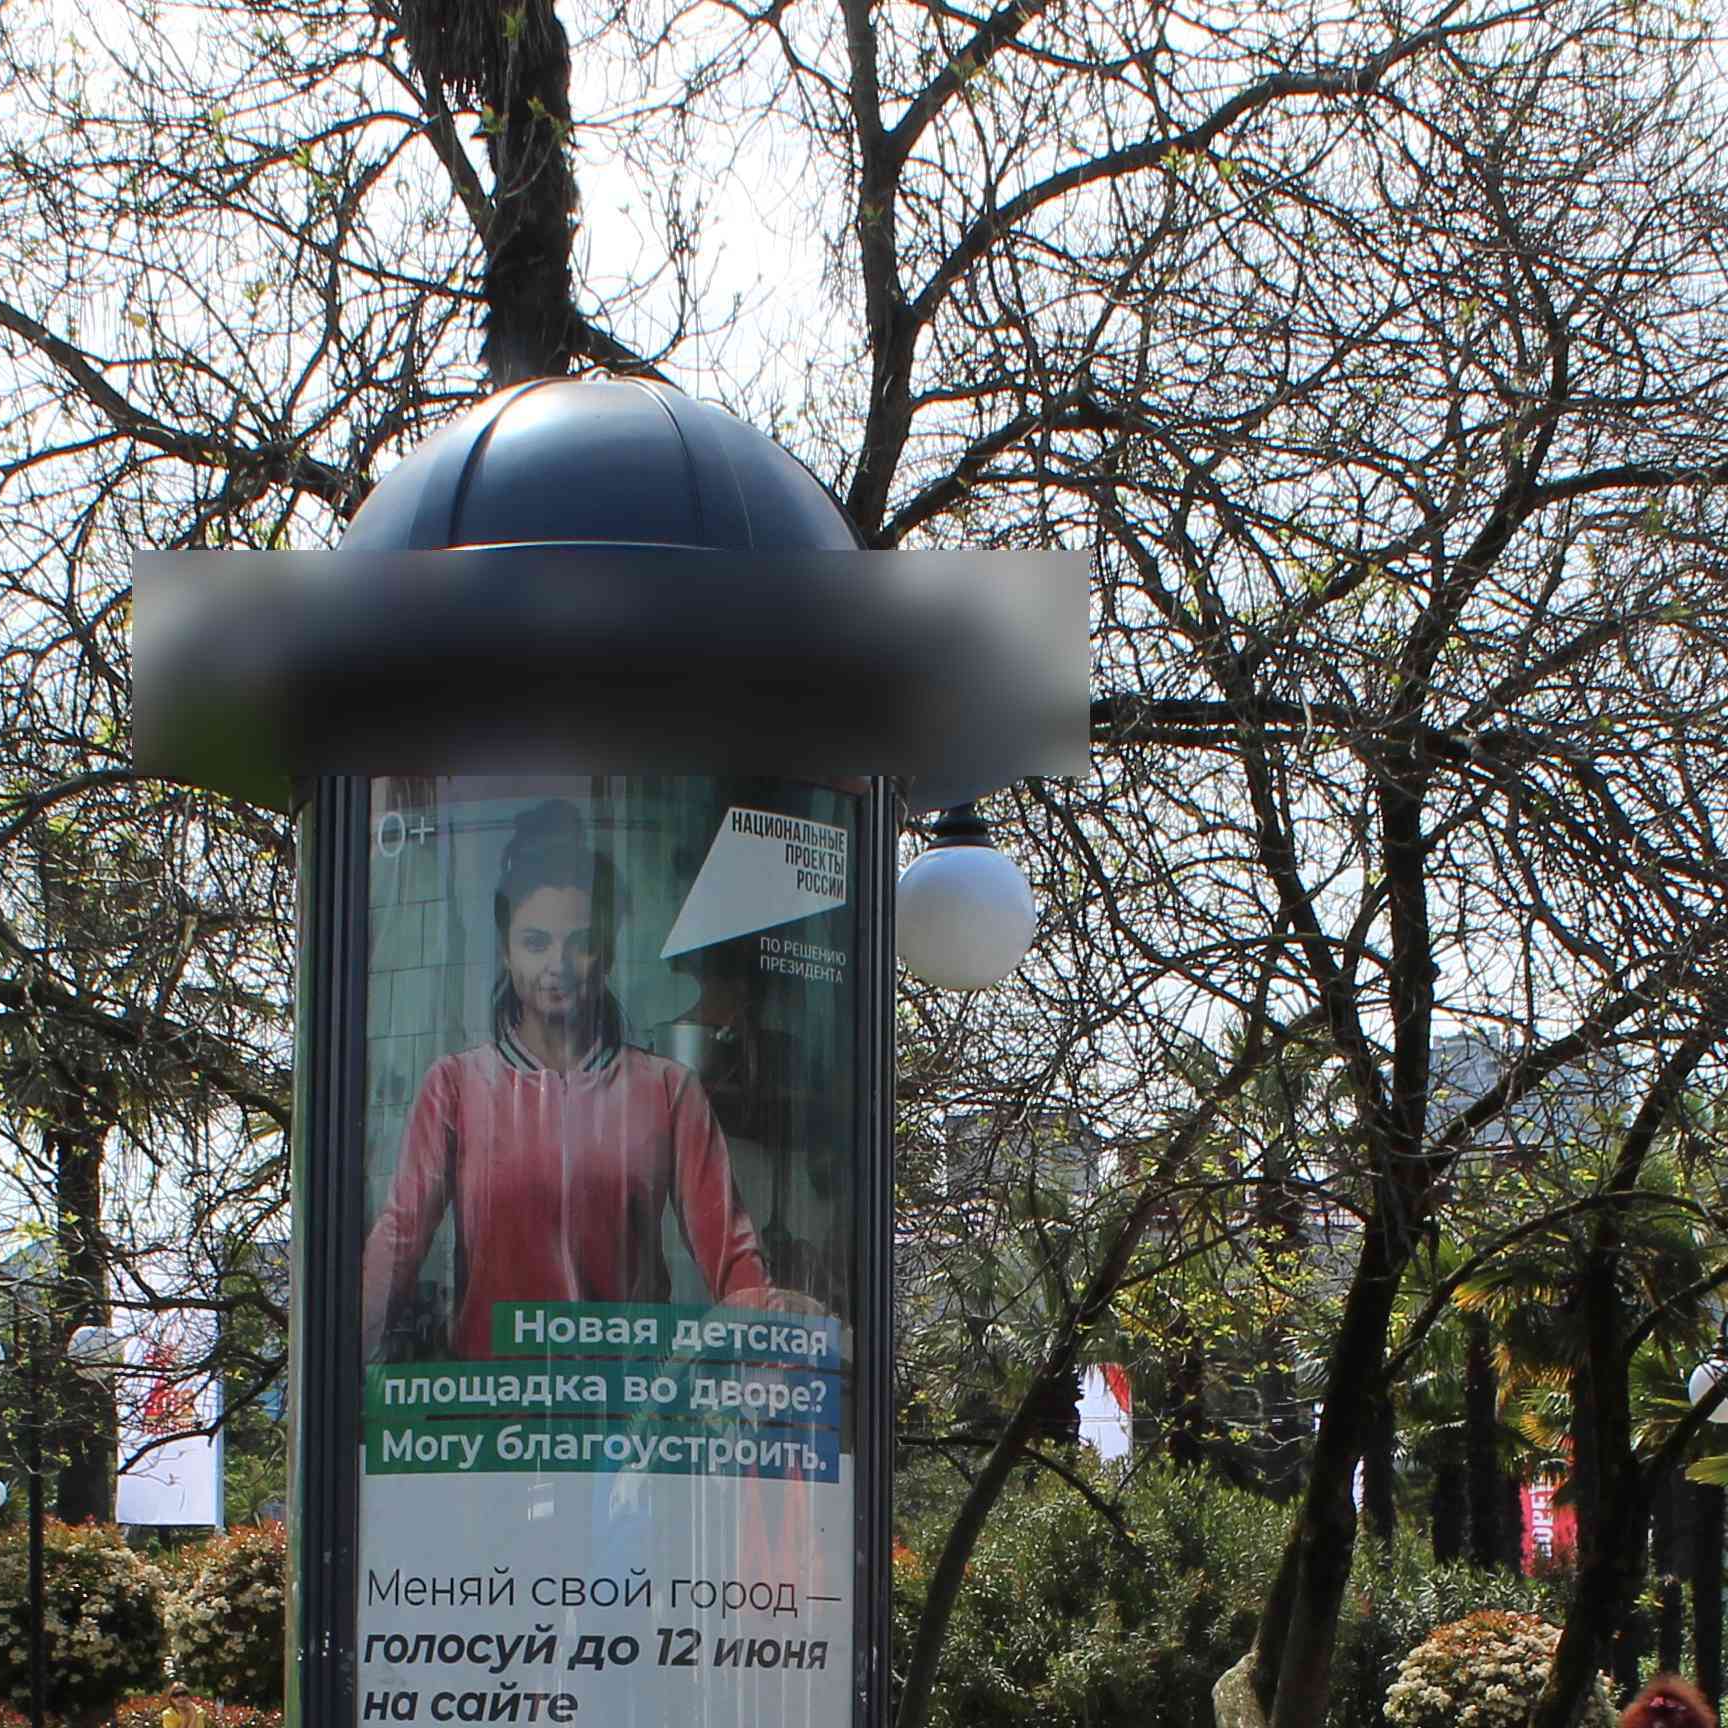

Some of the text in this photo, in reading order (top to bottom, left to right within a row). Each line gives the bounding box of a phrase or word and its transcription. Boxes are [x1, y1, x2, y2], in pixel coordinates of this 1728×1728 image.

[377, 811, 434, 857] 0+
[732, 811, 845, 853] НАЦИОНАЛЬНЫЕ
[785, 843, 844, 877] ПРОЕКТЫ
[797, 869, 844, 900] РОССИИ
[760, 936, 847, 967] ПО РЕШЕНИЮ
[760, 955, 844, 984] ПРЕЗИДЕНТА
[514, 1309, 828, 1357] Новая детская
[384, 1374, 827, 1418] площадка во дворе?
[382, 1423, 827, 1473] Могу благоустроить.
[367, 1566, 515, 1607] Меняй
[531, 1567, 652, 1608] свой
[671, 1578, 798, 1619] город
[364, 1623, 829, 1674] голосуй до 12 июня
[363, 1681, 579, 1723] на сайте
